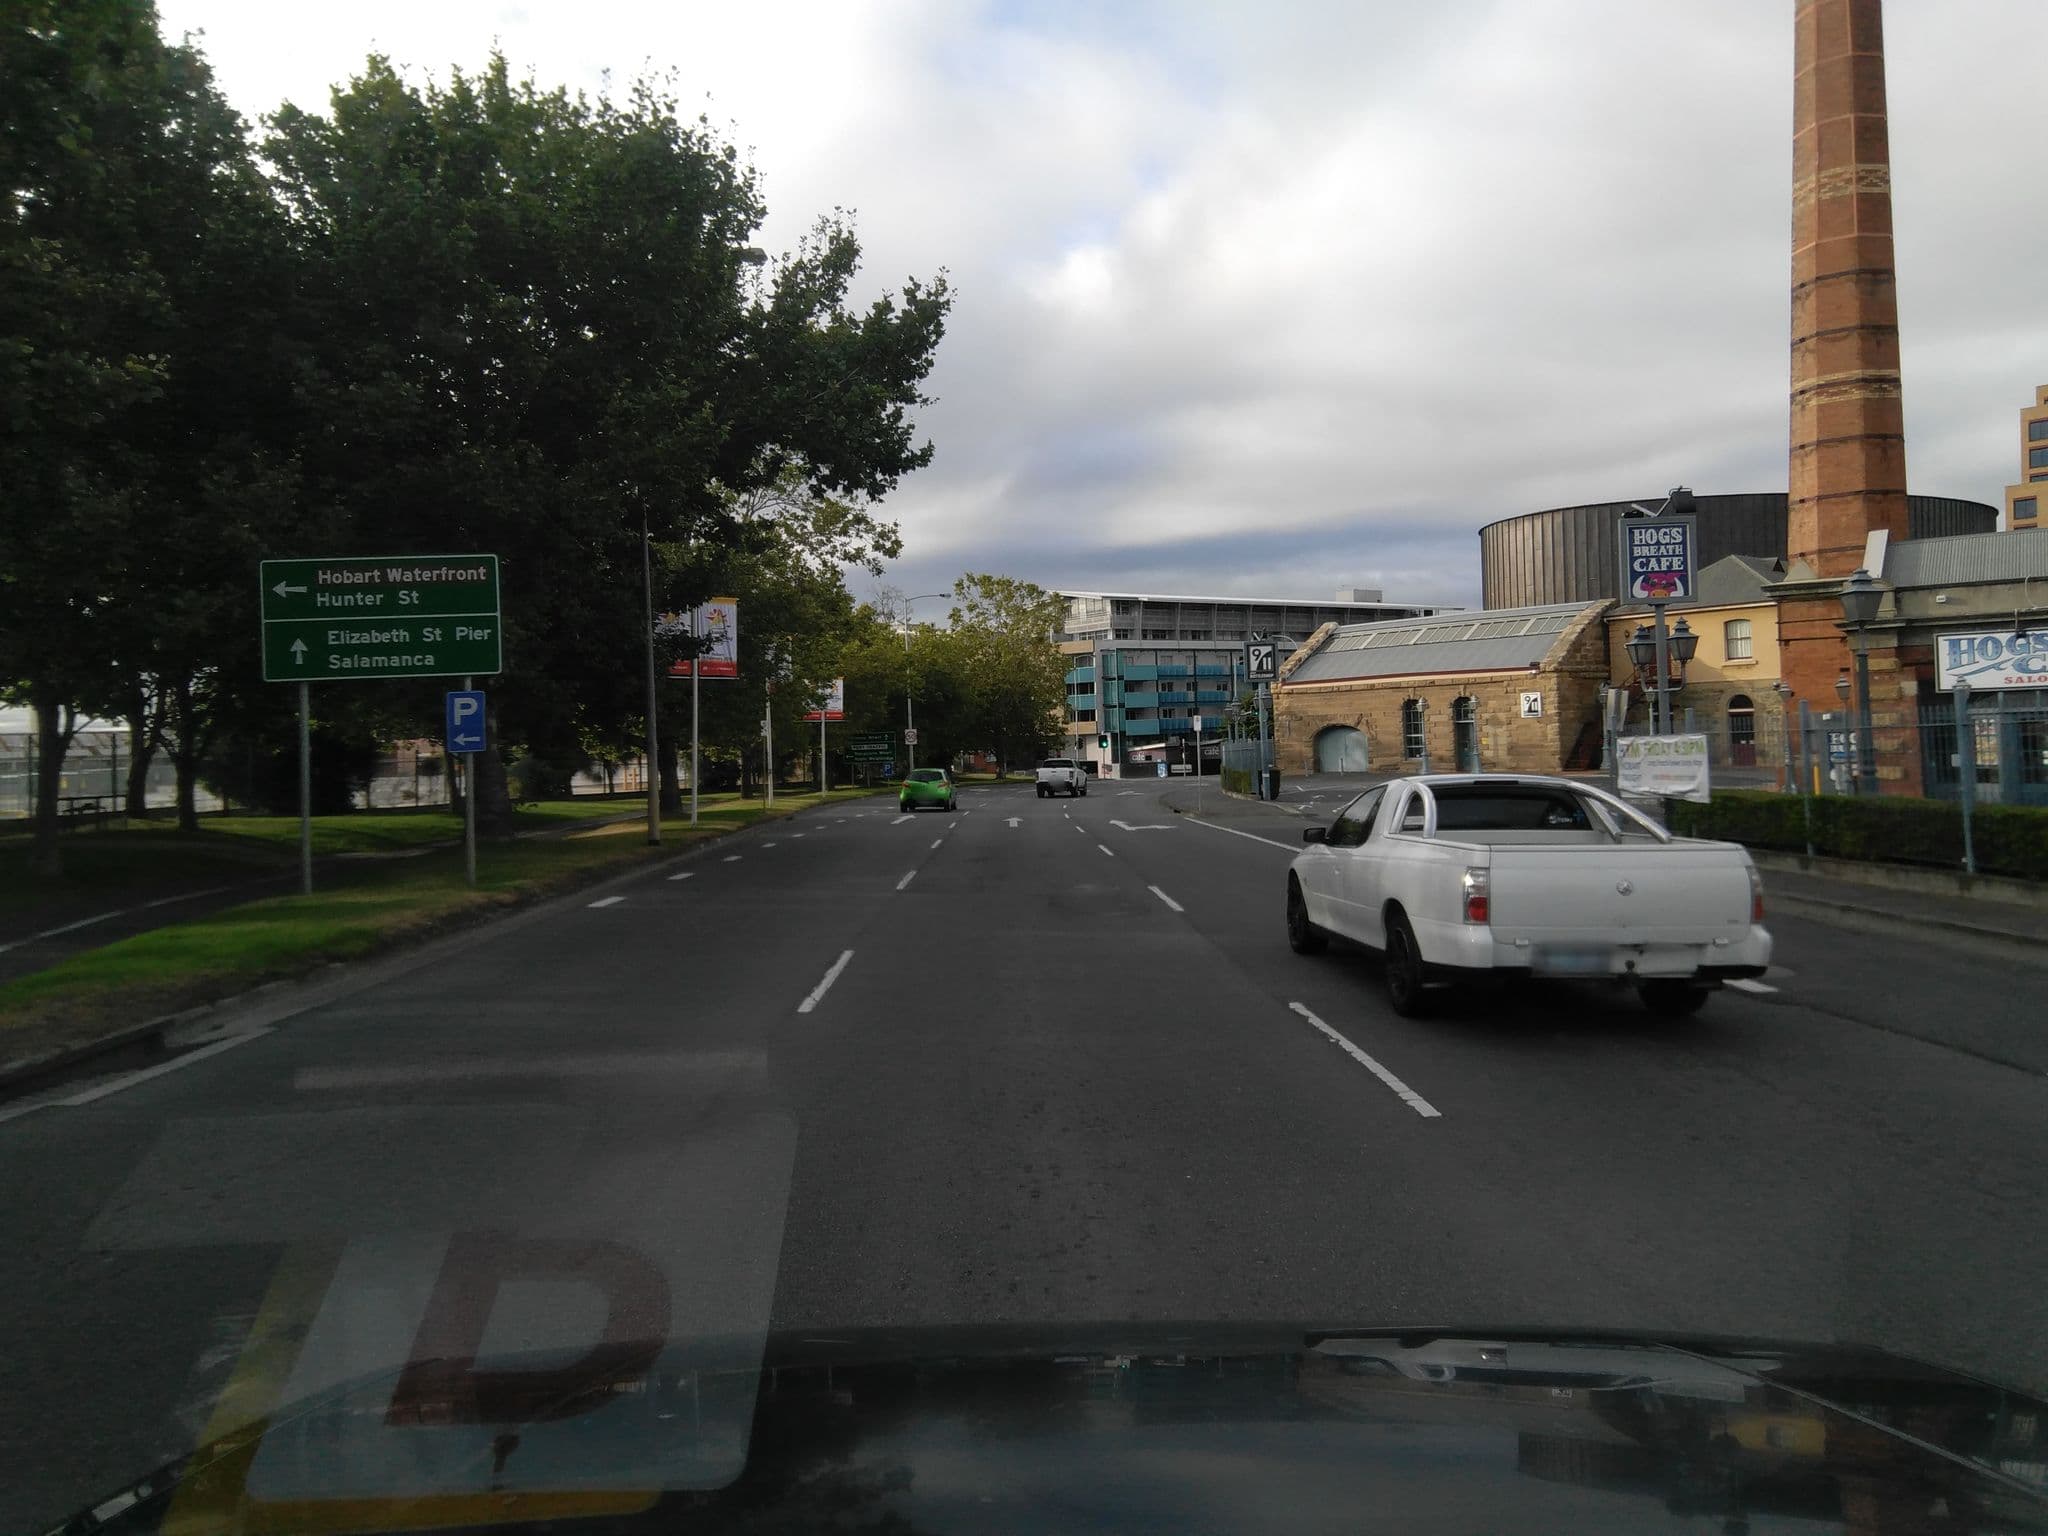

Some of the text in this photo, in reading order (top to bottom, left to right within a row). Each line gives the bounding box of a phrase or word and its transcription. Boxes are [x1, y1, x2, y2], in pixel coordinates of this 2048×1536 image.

[1632, 527, 1683, 545] HOGS
[1632, 544, 1684, 557] BREATH
[1633, 556, 1684, 572] CAFE
[318, 565, 487, 585] Hobart Waterfront
[316, 590, 420, 607] Hunter St
[327, 625, 491, 645] Elizabeth St Pier
[328, 652, 435, 669] Salamanca
[453, 697, 478, 726] P
